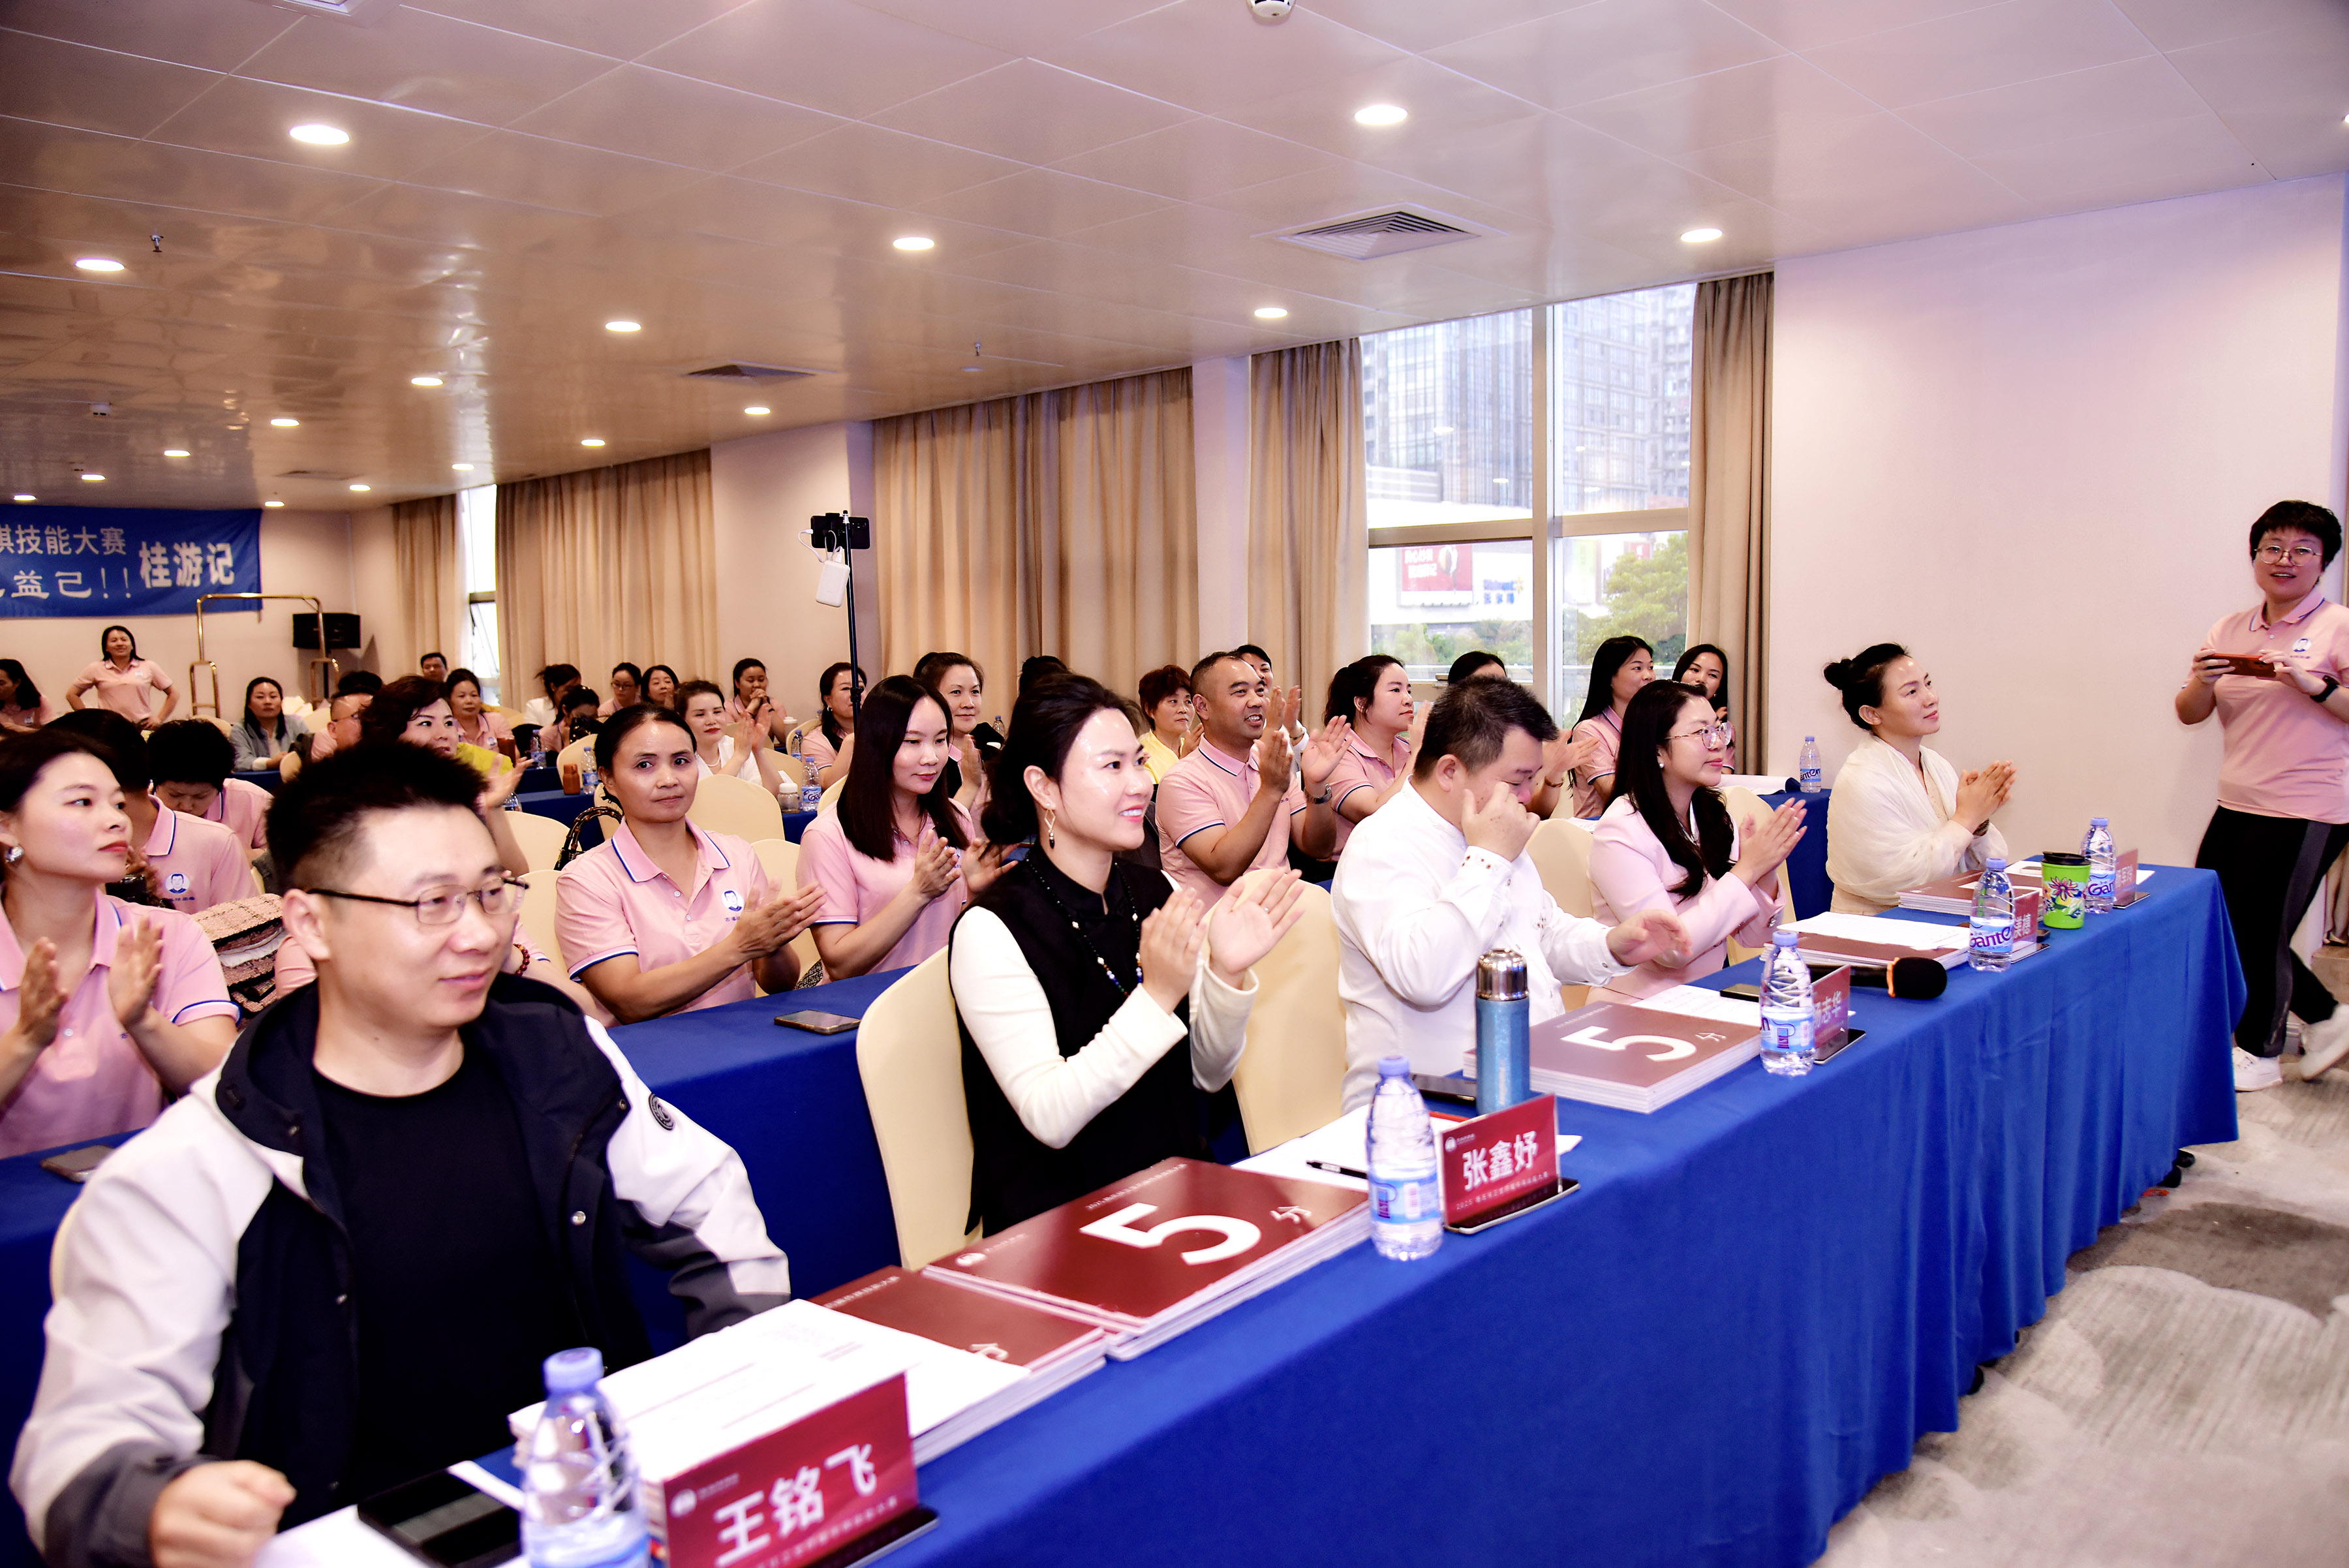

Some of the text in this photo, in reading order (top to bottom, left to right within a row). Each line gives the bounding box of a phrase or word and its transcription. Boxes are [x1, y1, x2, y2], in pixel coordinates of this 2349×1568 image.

[0, 568, 131, 599] 益己!!
[139, 542, 234, 589] 桂游记
[1560, 1026, 1727, 1062] 5 分
[1079, 1202, 1312, 1267] 5 分
[713, 1443, 877, 1568] 王铭飞
